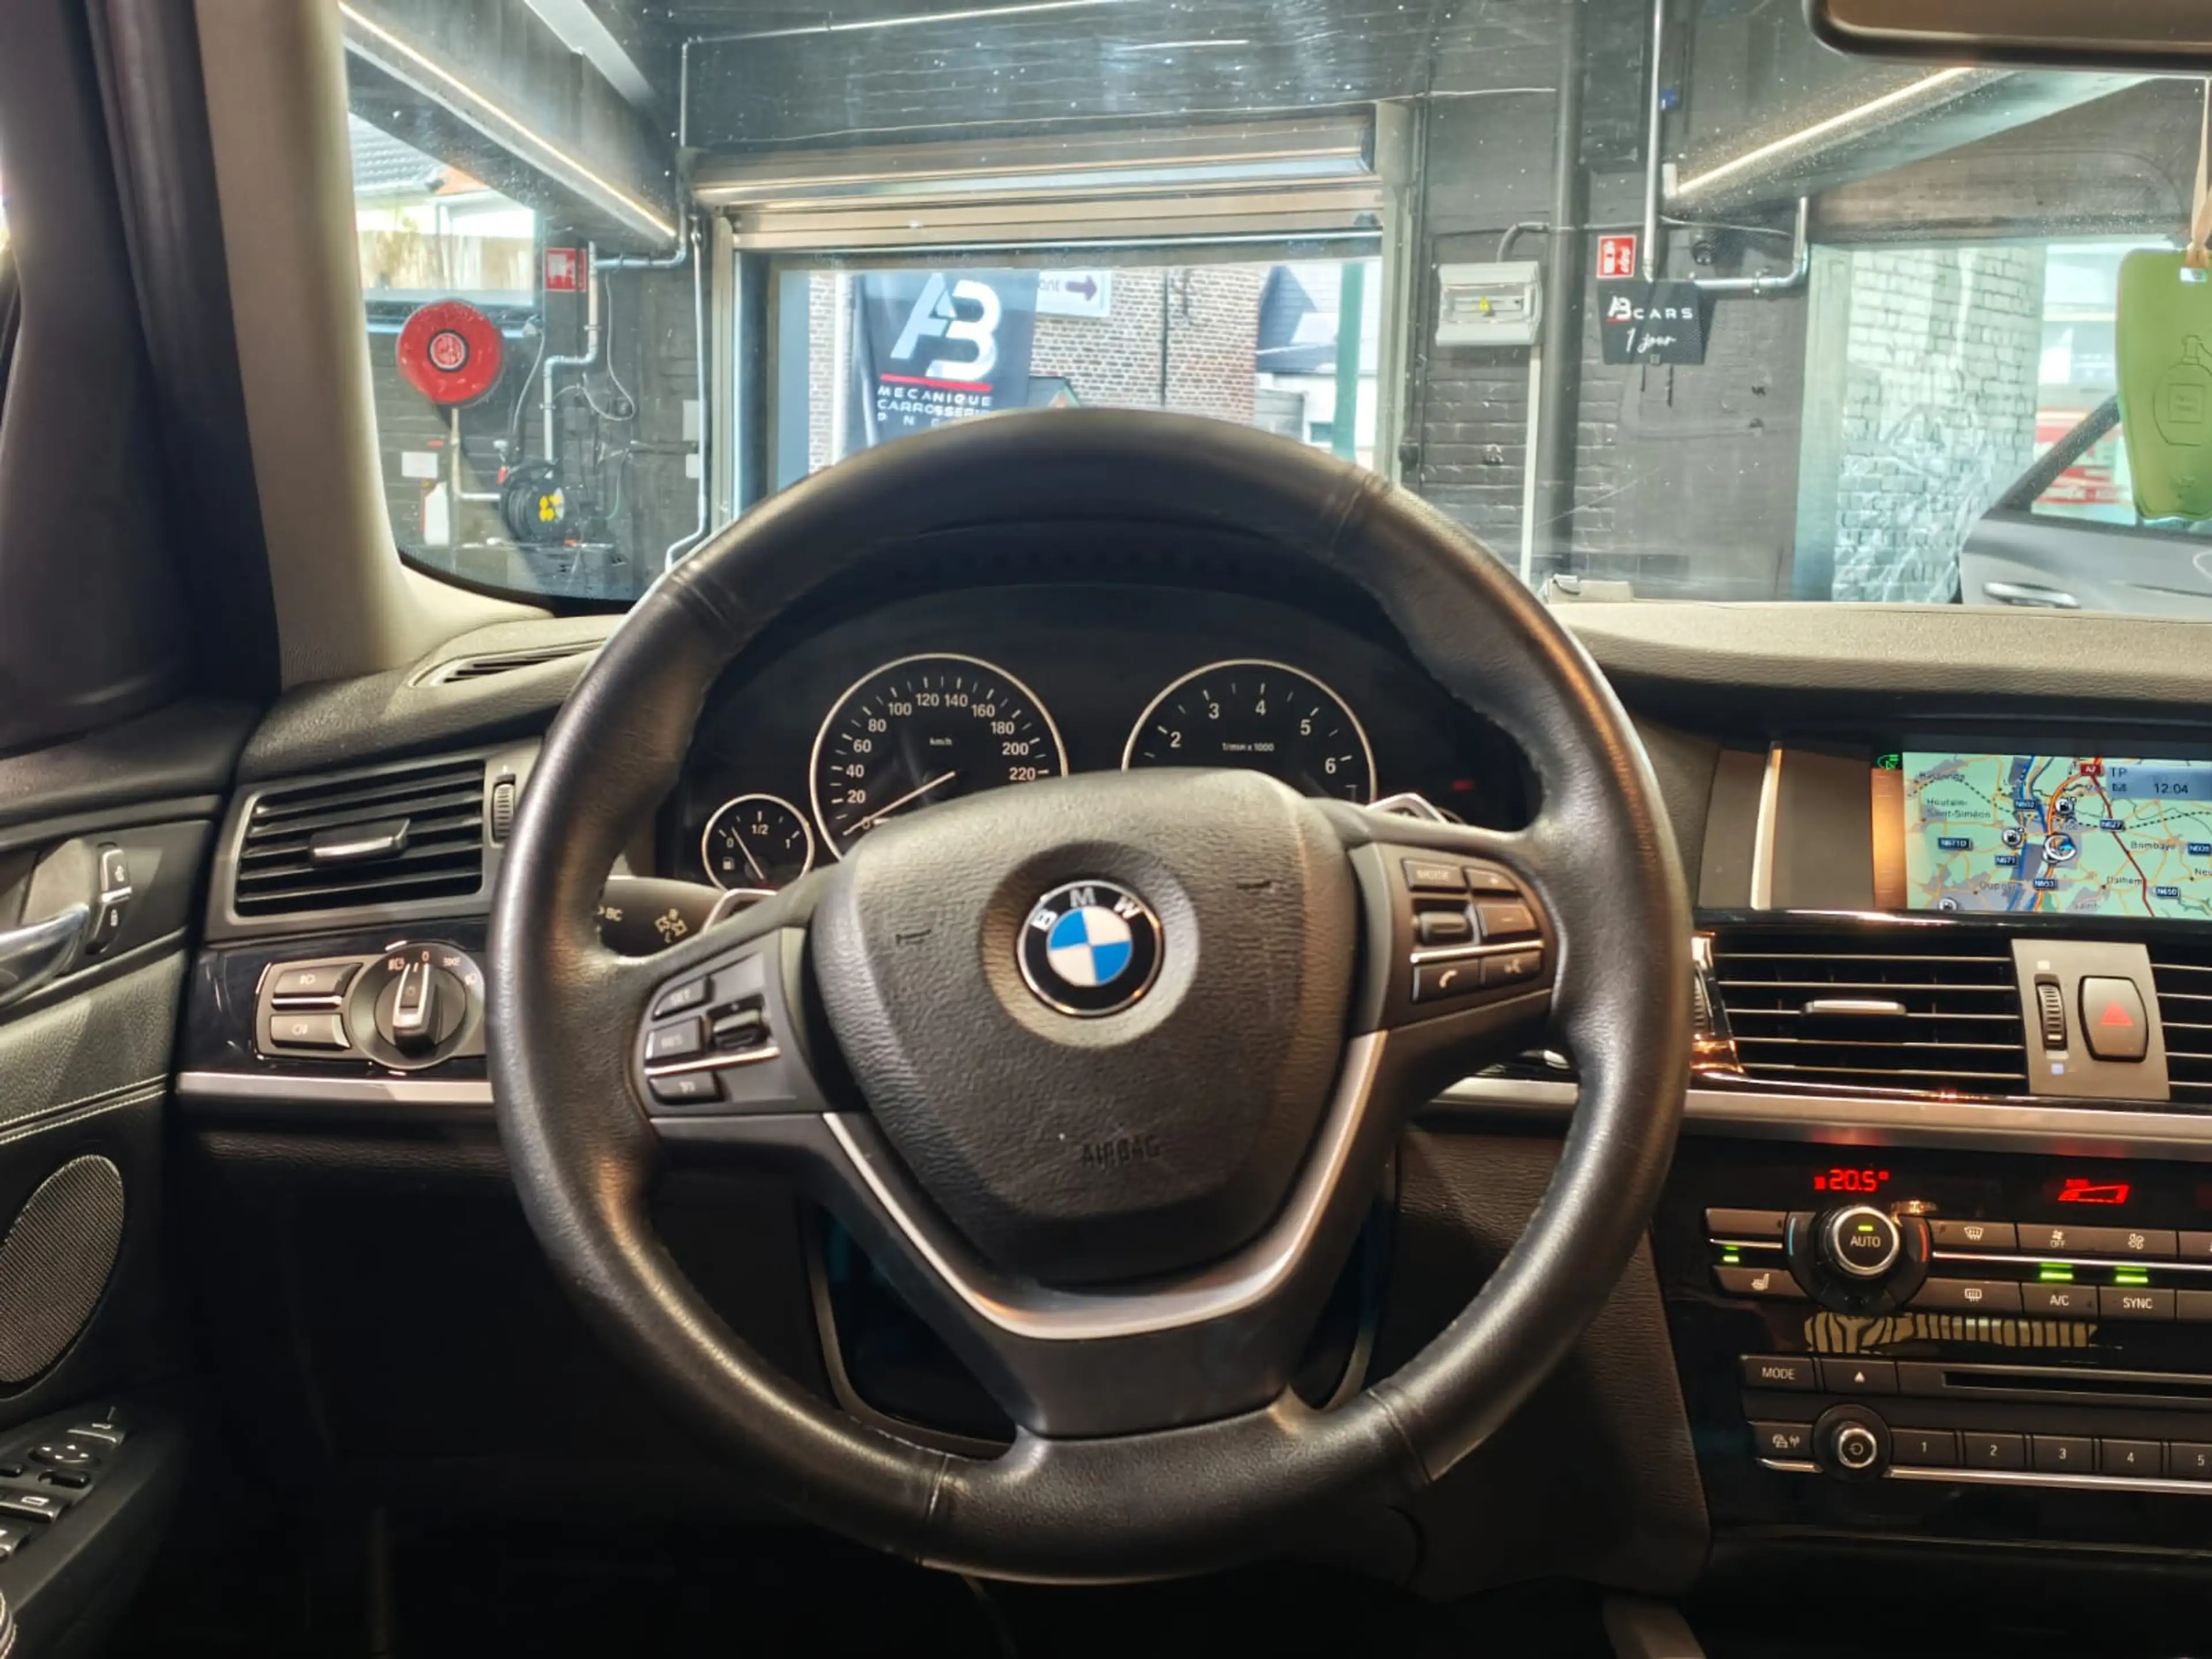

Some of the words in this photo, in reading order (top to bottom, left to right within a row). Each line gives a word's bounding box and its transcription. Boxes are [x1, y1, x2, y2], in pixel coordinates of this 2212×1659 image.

[1633, 307, 1694, 320] CARS
[877, 384, 993, 407] MECANIQUE
[915, 693, 940, 707] 120
[944, 694, 968, 707] 140
[1255, 699, 1266, 715] 4
[888, 702, 912, 716] 100
[971, 703, 995, 718] 160
[1208, 702, 1219, 719] 3
[868, 718, 887, 732] 80
[990, 721, 1016, 734] 180
[1300, 719, 1311, 736] 5
[853, 738, 872, 753] 60
[1170, 731, 1181, 748] 2
[1002, 742, 1029, 756] 200
[846, 764, 865, 778] 40
[1325, 757, 1336, 774] 6
[1009, 767, 1036, 781] 220
[2153, 783, 2189, 794] 12:04
[846, 789, 866, 804] 20
[751, 823, 769, 835] 1/2
[726, 837, 734, 849] 0
[785, 838, 791, 850] 1
[605, 906, 624, 922] BC
[1030, 887, 1141, 933] BMW
[1850, 1235, 1881, 1248] AUTO
[2050, 1294, 2069, 1306] A/C
[2123, 1297, 2153, 1309] SYNC
[1762, 1366, 1797, 1381] MODE
[1922, 1441, 1927, 1453] 1
[1990, 1444, 1997, 1456] 2
[2059, 1448, 2067, 1460] 3
[2127, 1452, 2134, 1463] 4
[2198, 1455, 2205, 1467] 5
